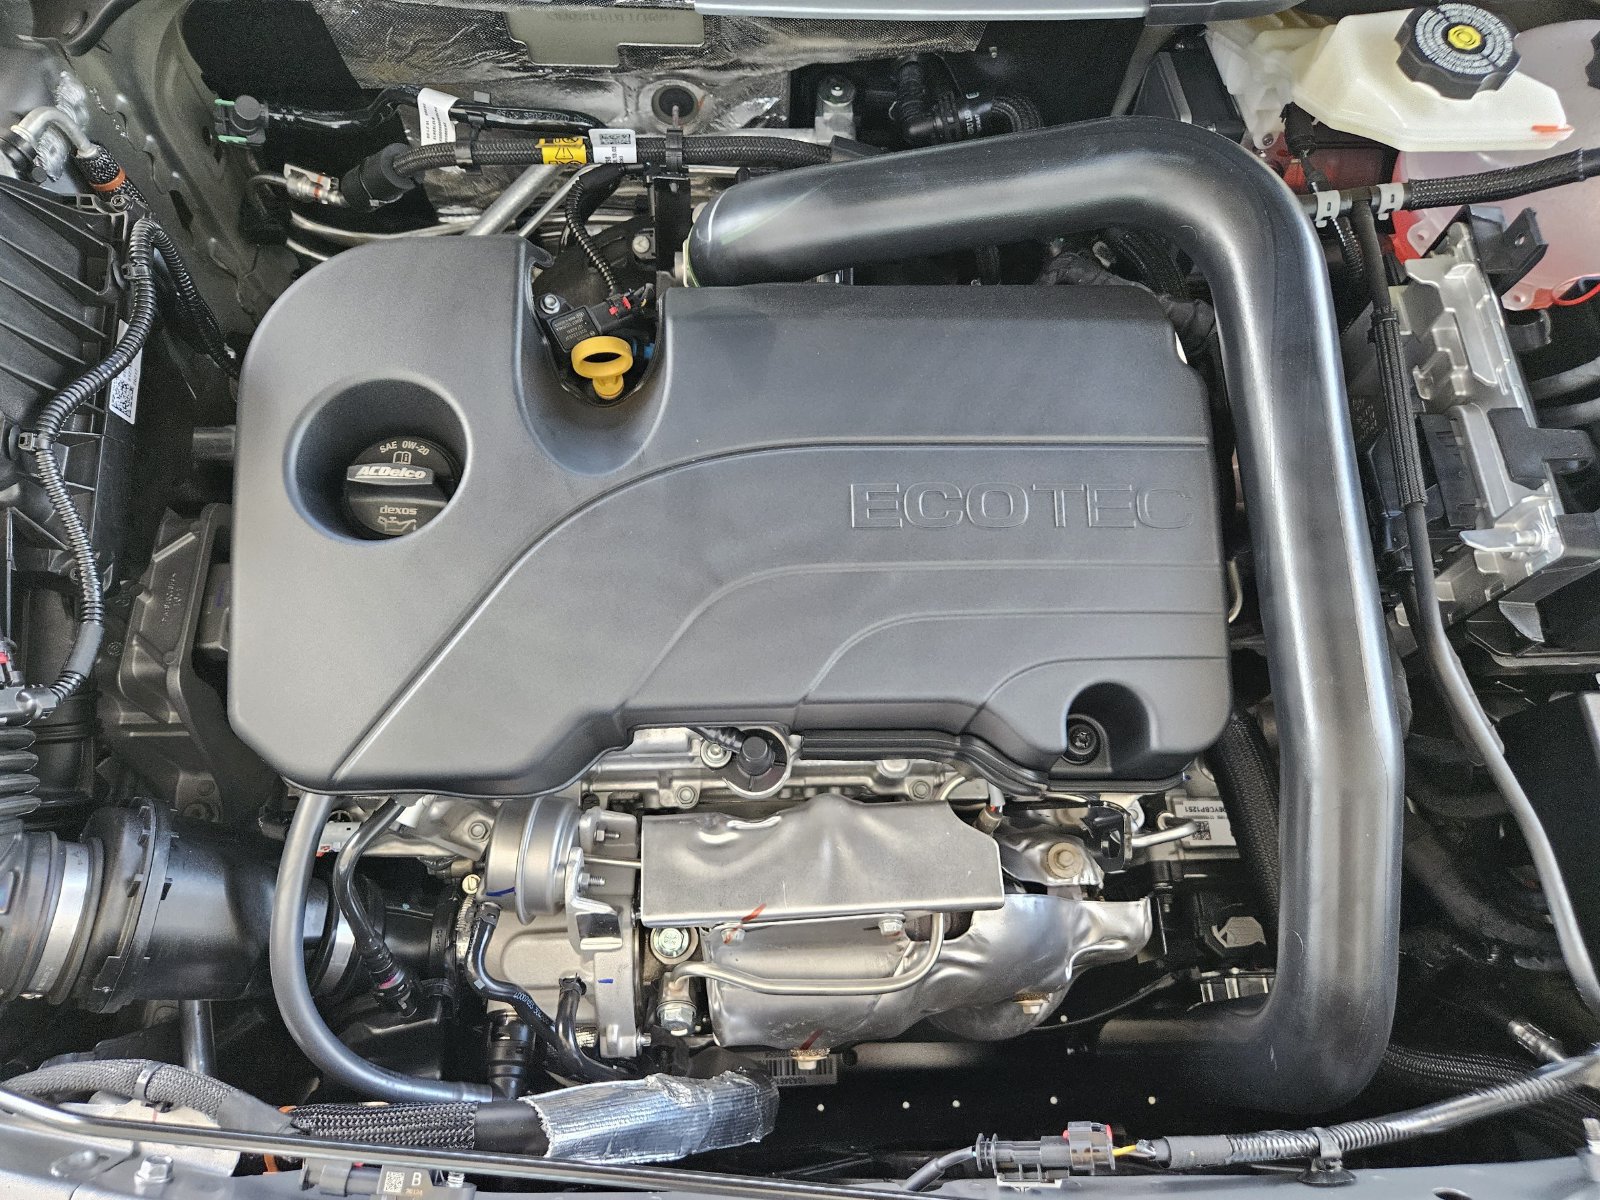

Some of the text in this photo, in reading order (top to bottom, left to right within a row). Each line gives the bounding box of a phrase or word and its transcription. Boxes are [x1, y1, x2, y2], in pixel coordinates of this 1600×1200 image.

[379, 440, 430, 456] SAE 0W-20
[355, 466, 426, 479] ACDelco
[379, 504, 418, 515] dexos
[850, 481, 1194, 530] ECOTEC
[411, 1171, 422, 1186] B
